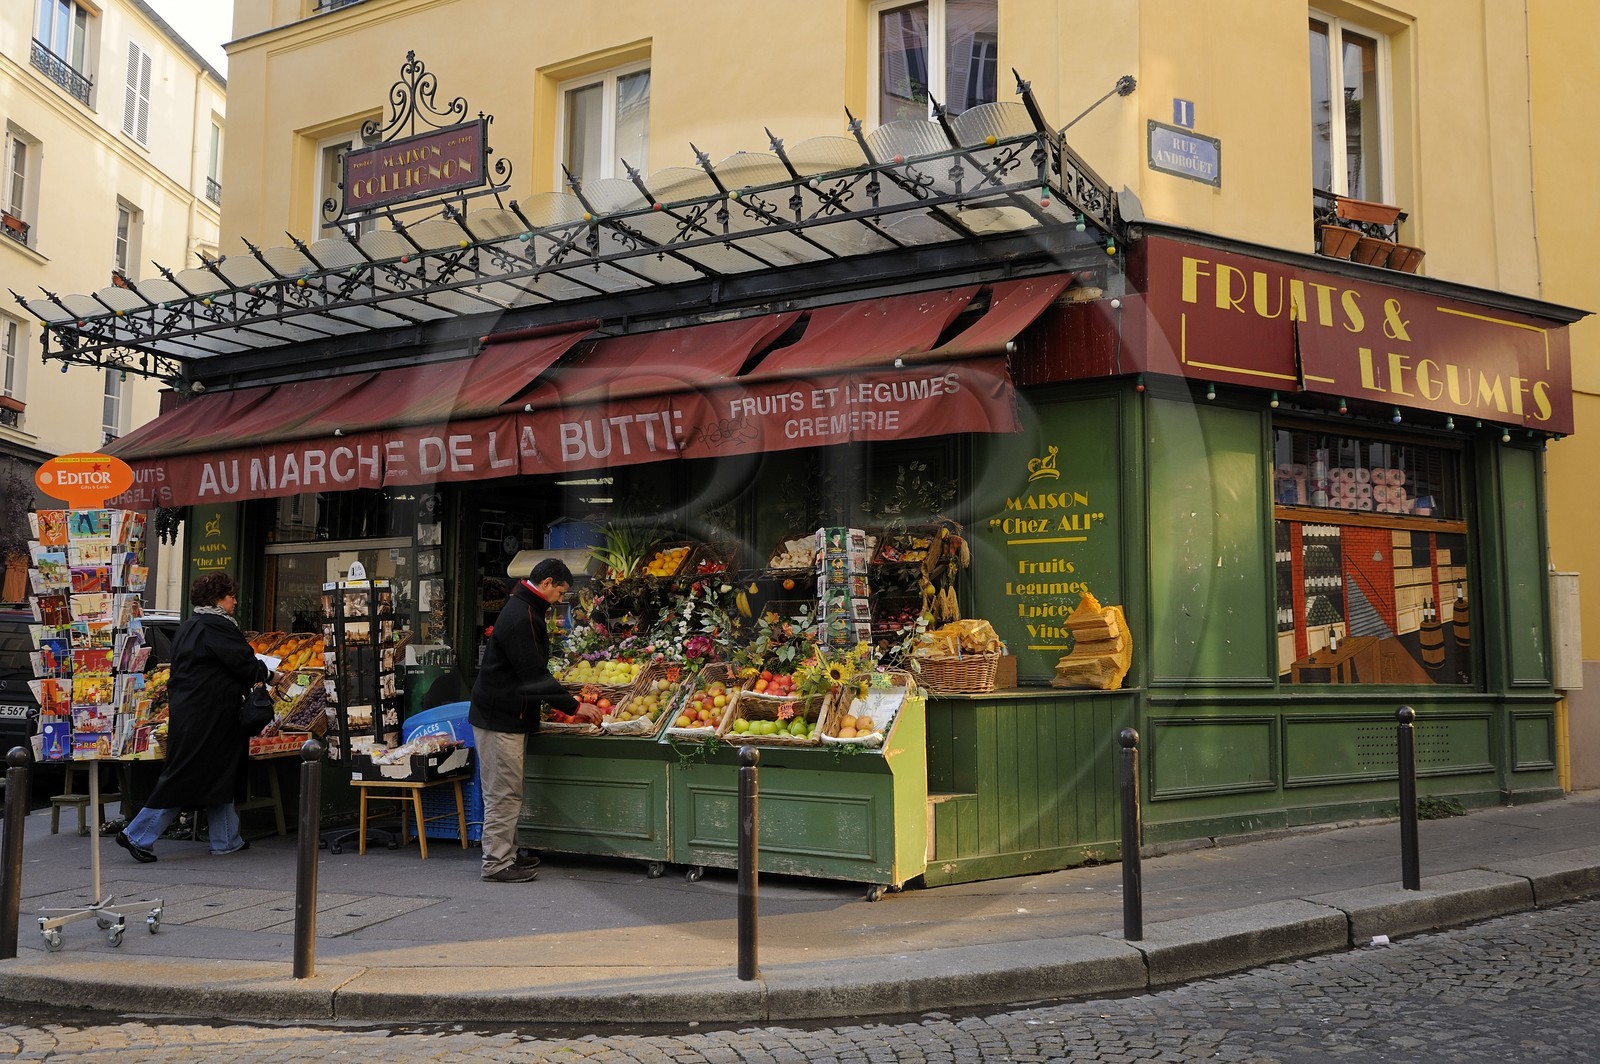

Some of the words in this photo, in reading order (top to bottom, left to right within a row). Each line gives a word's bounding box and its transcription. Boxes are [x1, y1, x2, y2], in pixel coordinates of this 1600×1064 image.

[382, 143, 441, 168] MAISON
[1172, 137, 1197, 154] RUE
[1156, 149, 1213, 175] ANDROÜET
[353, 154, 473, 199] COLLIGNON
[1182, 256, 1365, 333] FRUITS
[1382, 298, 1412, 341] &
[730, 391, 804, 419] FRUITS
[811, 387, 839, 409] ET
[845, 372, 960, 405] LEGUMES
[1358, 347, 1552, 421] LEGUMES
[784, 410, 900, 439] CREMERIE
[198, 459, 240, 496] AU
[250, 440, 409, 491] MARCHE
[418, 434, 474, 475] DE
[488, 426, 543, 469] LA
[560, 410, 686, 462] BUTTE
[1004, 491, 1088, 511] MAISON
[199, 543, 227, 552] MAISON
[1018, 558, 1075, 574] Fruits
[1005, 581, 1089, 595] Legumes
[1026, 623, 1069, 639] Vins
[7, 706, 25, 716] 567
